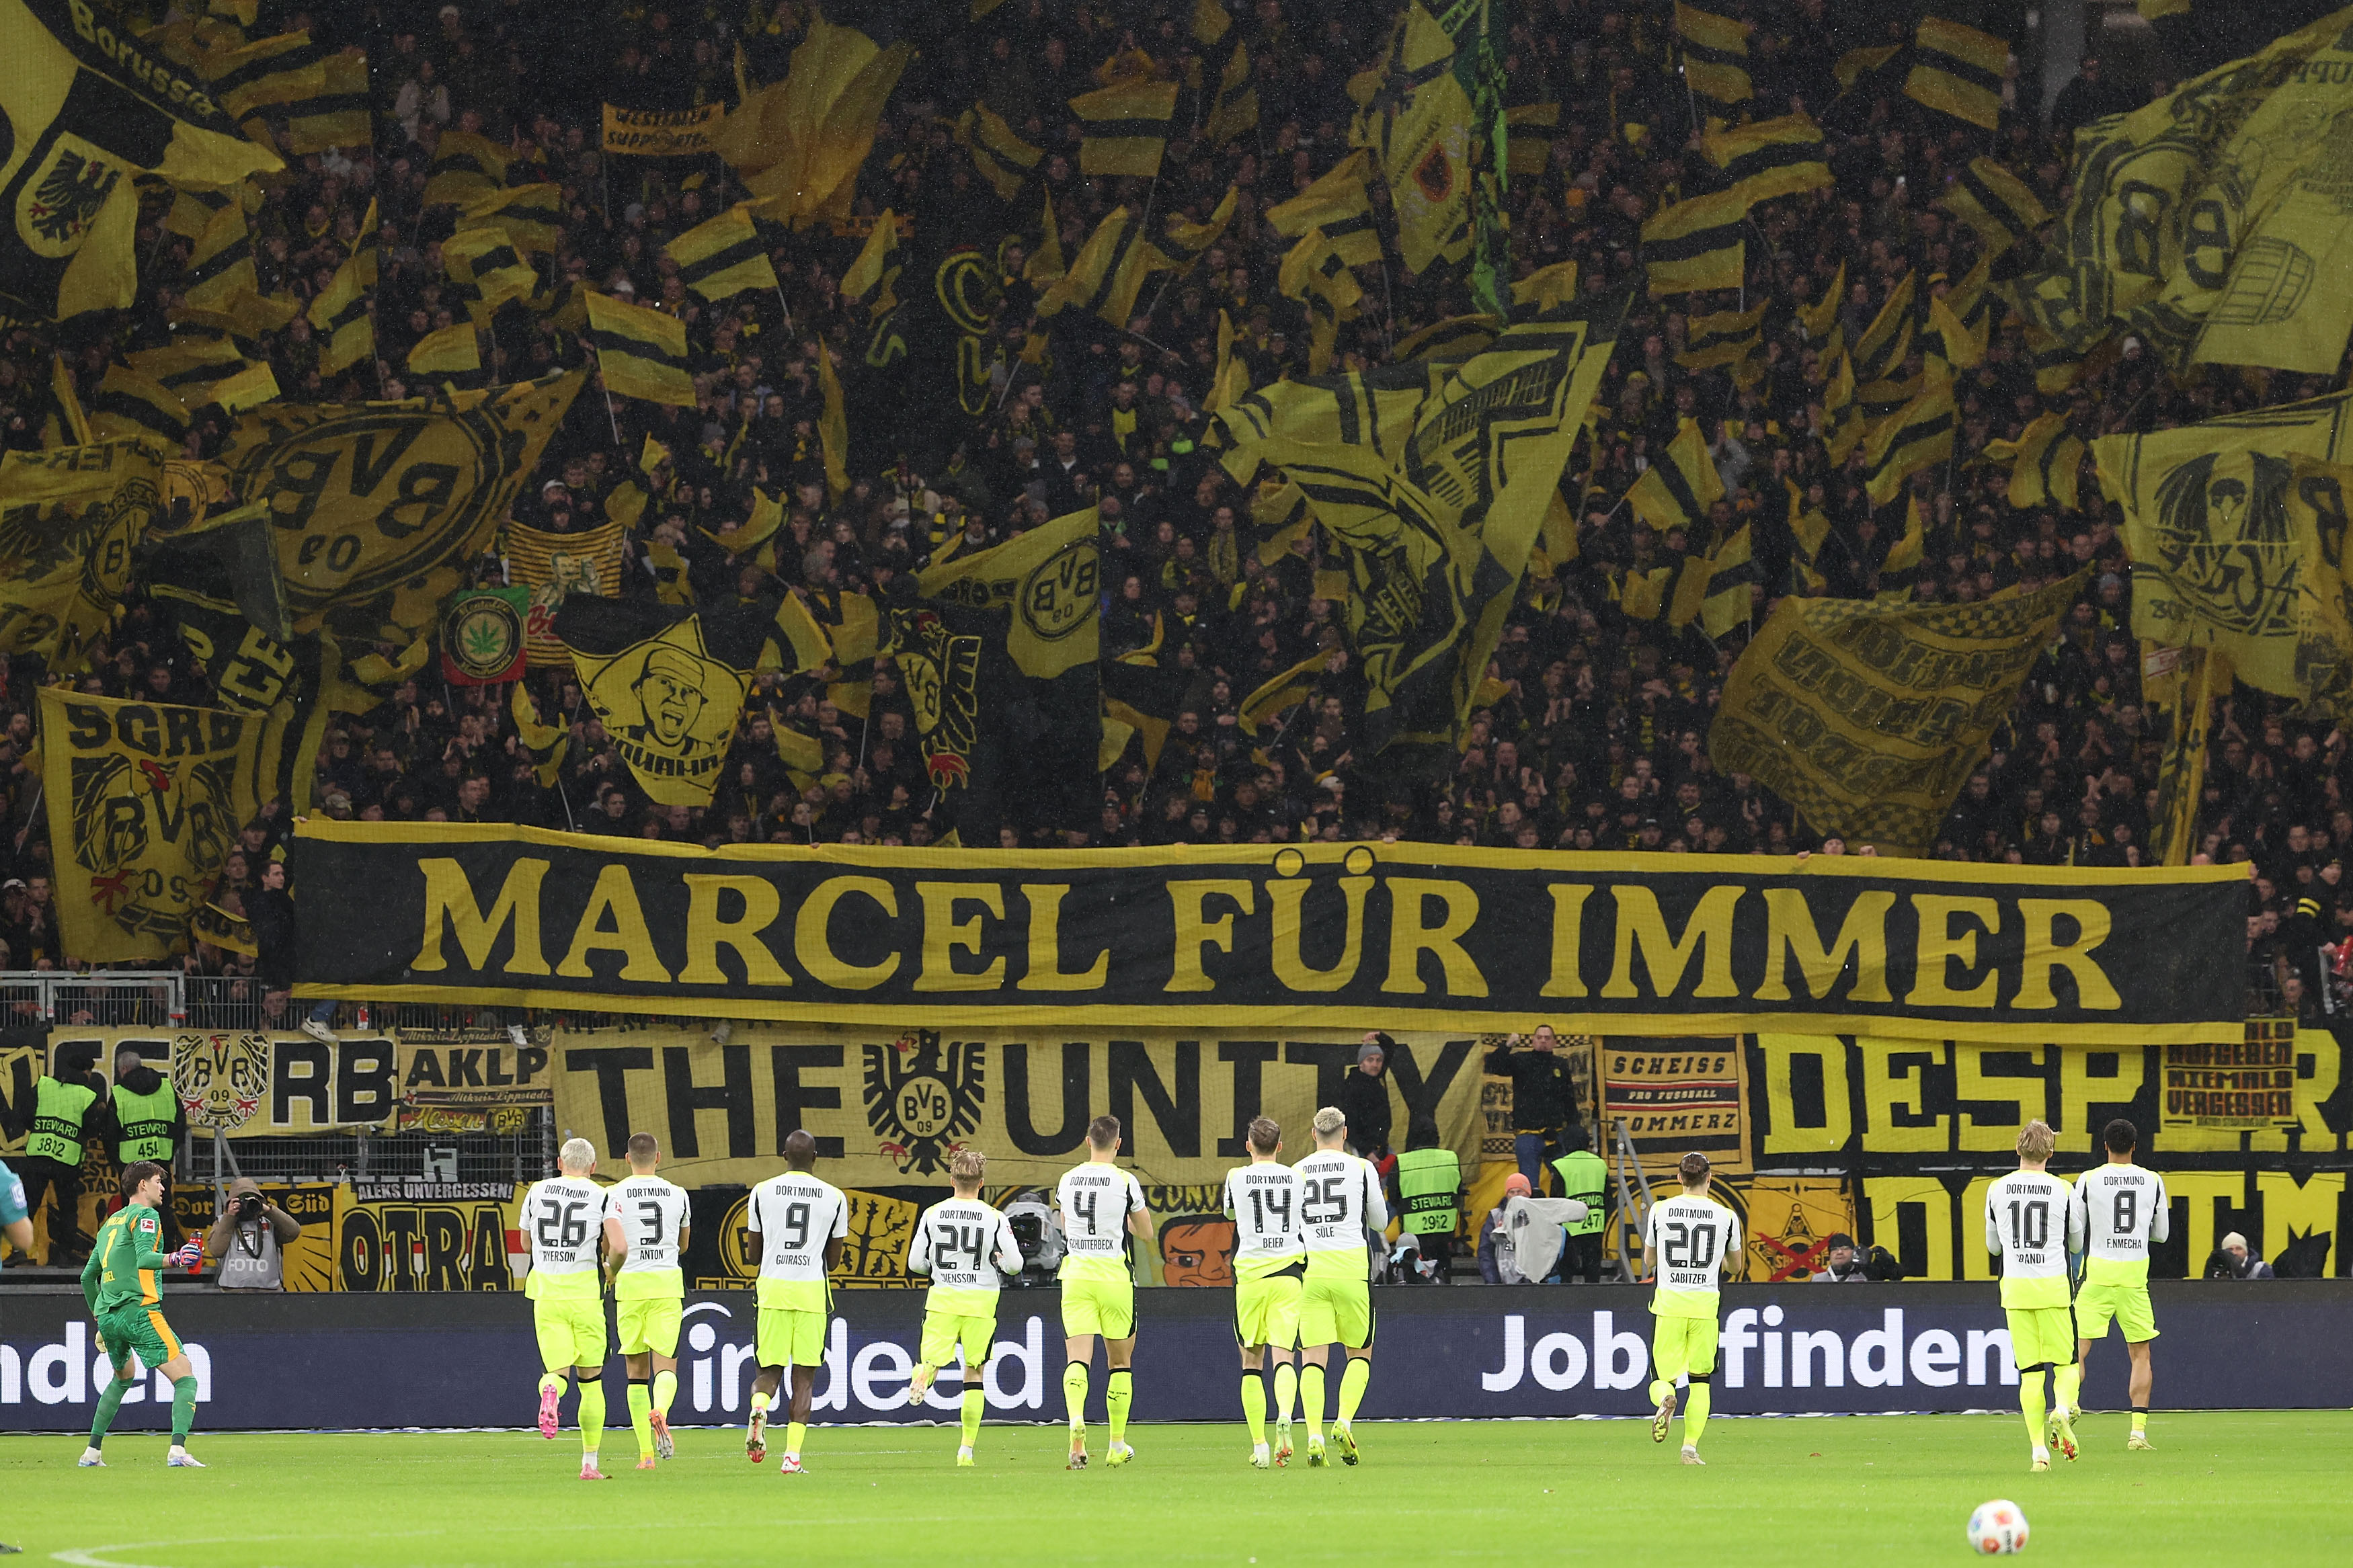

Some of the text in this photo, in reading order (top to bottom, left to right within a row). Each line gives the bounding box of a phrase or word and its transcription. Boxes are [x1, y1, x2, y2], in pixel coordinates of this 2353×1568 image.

[411, 846, 2122, 1012] MARCEL FÜR IMMER
[405, 1047, 549, 1087] AKLP
[1613, 1055, 1727, 1075] SCHEISS
[2167, 1071, 2293, 1089] NIEMALS
[210, 1089, 229, 1102] 09
[565, 1040, 1477, 1159] THE UNITY
[904, 1083, 947, 1121] BVB
[1628, 1089, 1718, 1100] PRO FUSSBALL
[2167, 1090, 2292, 1116] VERGESSEN
[917, 1120, 932, 1132] 09
[1302, 1161, 1345, 1173] DORTMUND
[1069, 1175, 1111, 1188] DORTMUND
[1246, 1174, 1293, 1186] DORTMUND
[2104, 1175, 2145, 1186] DORTMUND
[358, 1182, 514, 1200] ALEKS UNVERGESSEN!
[544, 1184, 590, 1199] DORTMUND
[627, 1187, 671, 1198] DORTMUND
[775, 1185, 824, 1199] DORTMUND
[2005, 1183, 2052, 1196] DORTMUND
[286, 1194, 331, 1214] Süd
[1302, 1177, 1348, 1225] 25
[939, 1210, 984, 1222] DORTMUND
[1074, 1190, 1097, 1235] 4
[1248, 1188, 1291, 1233] 14
[1668, 1207, 1714, 1220] DORTMUND
[2114, 1190, 2137, 1234] 8
[537, 1198, 589, 1248] 26
[639, 1200, 663, 1245] 3
[785, 1202, 811, 1250] 9
[2007, 1200, 2049, 1249] 10
[1316, 1225, 1335, 1239] SÜLE
[102, 1228, 118, 1269] 1
[340, 1207, 513, 1291] OTRA
[935, 1225, 984, 1270] 24
[1069, 1238, 1115, 1251] SCHLOTTERBECK
[1263, 1237, 1284, 1249] BEIER
[1665, 1222, 1716, 1269] 20
[2106, 1237, 2143, 1250] F.NMECHA
[543, 1250, 576, 1263] RYERSON
[639, 1249, 664, 1261] ANTON
[775, 1253, 811, 1267] GUIRASSY
[227, 1258, 269, 1273] FOTO
[1669, 1272, 1707, 1285] SABITZER
[1482, 1305, 2020, 1392] Job finden
[688, 1315, 1043, 1412] indeed
